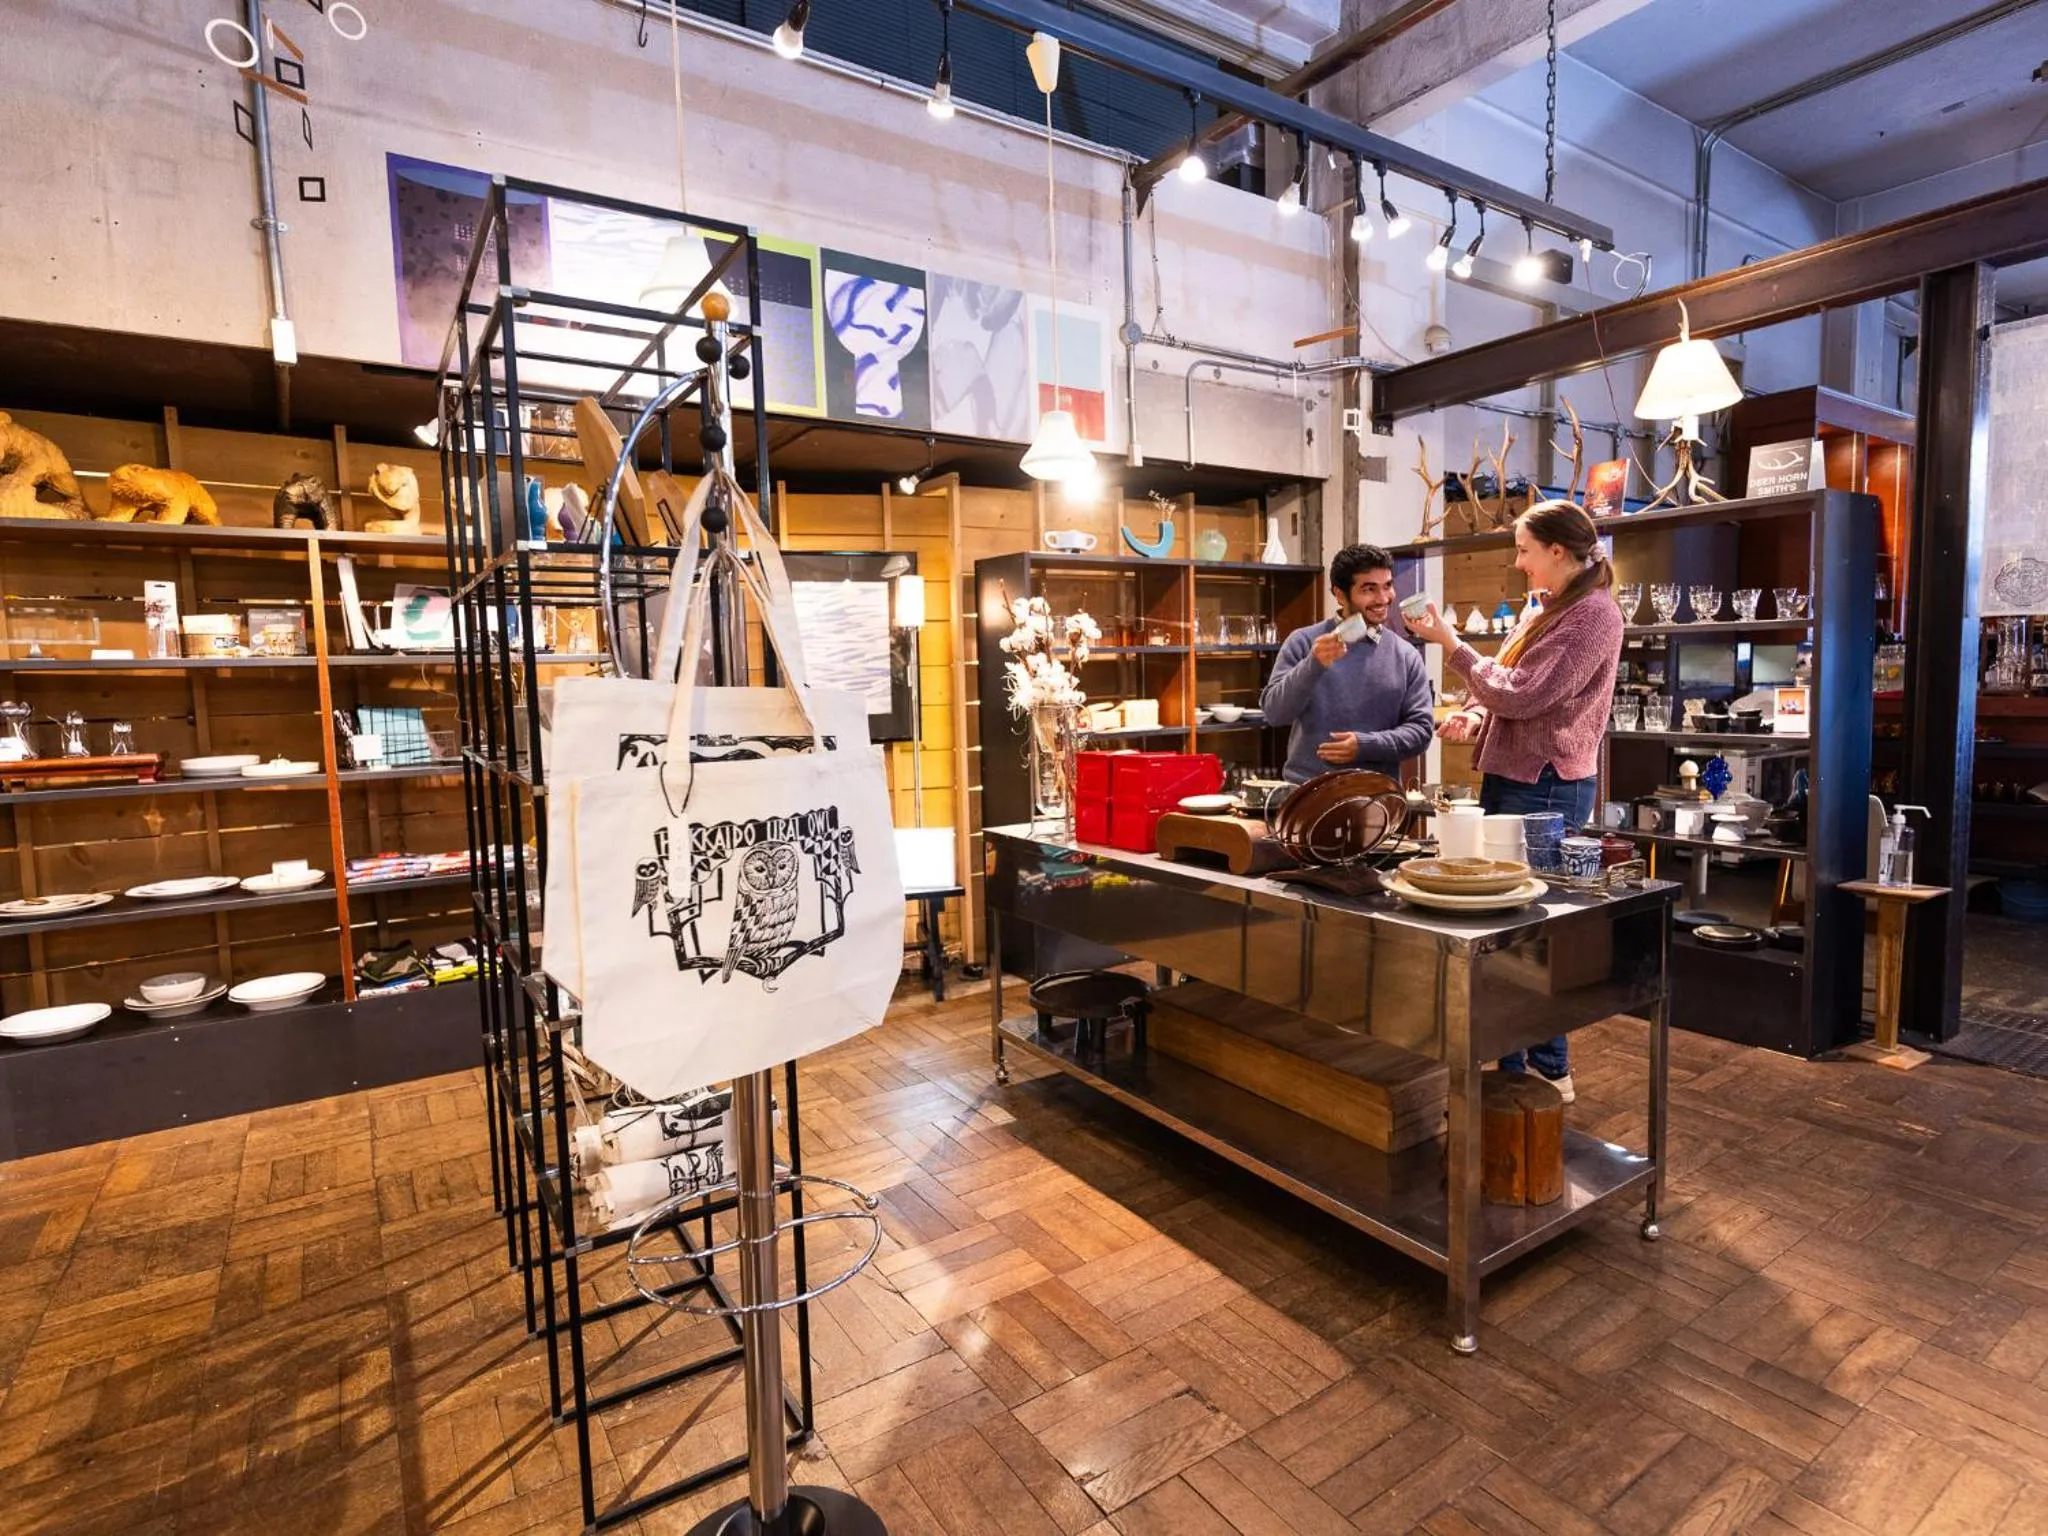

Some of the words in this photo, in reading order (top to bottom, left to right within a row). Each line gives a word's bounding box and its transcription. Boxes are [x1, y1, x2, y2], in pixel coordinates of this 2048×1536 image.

[1779, 472, 1807, 484] HORN
[660, 824, 756, 855] HKKAIDO
[767, 816, 805, 842] URAL
[808, 811, 836, 836] OWL
